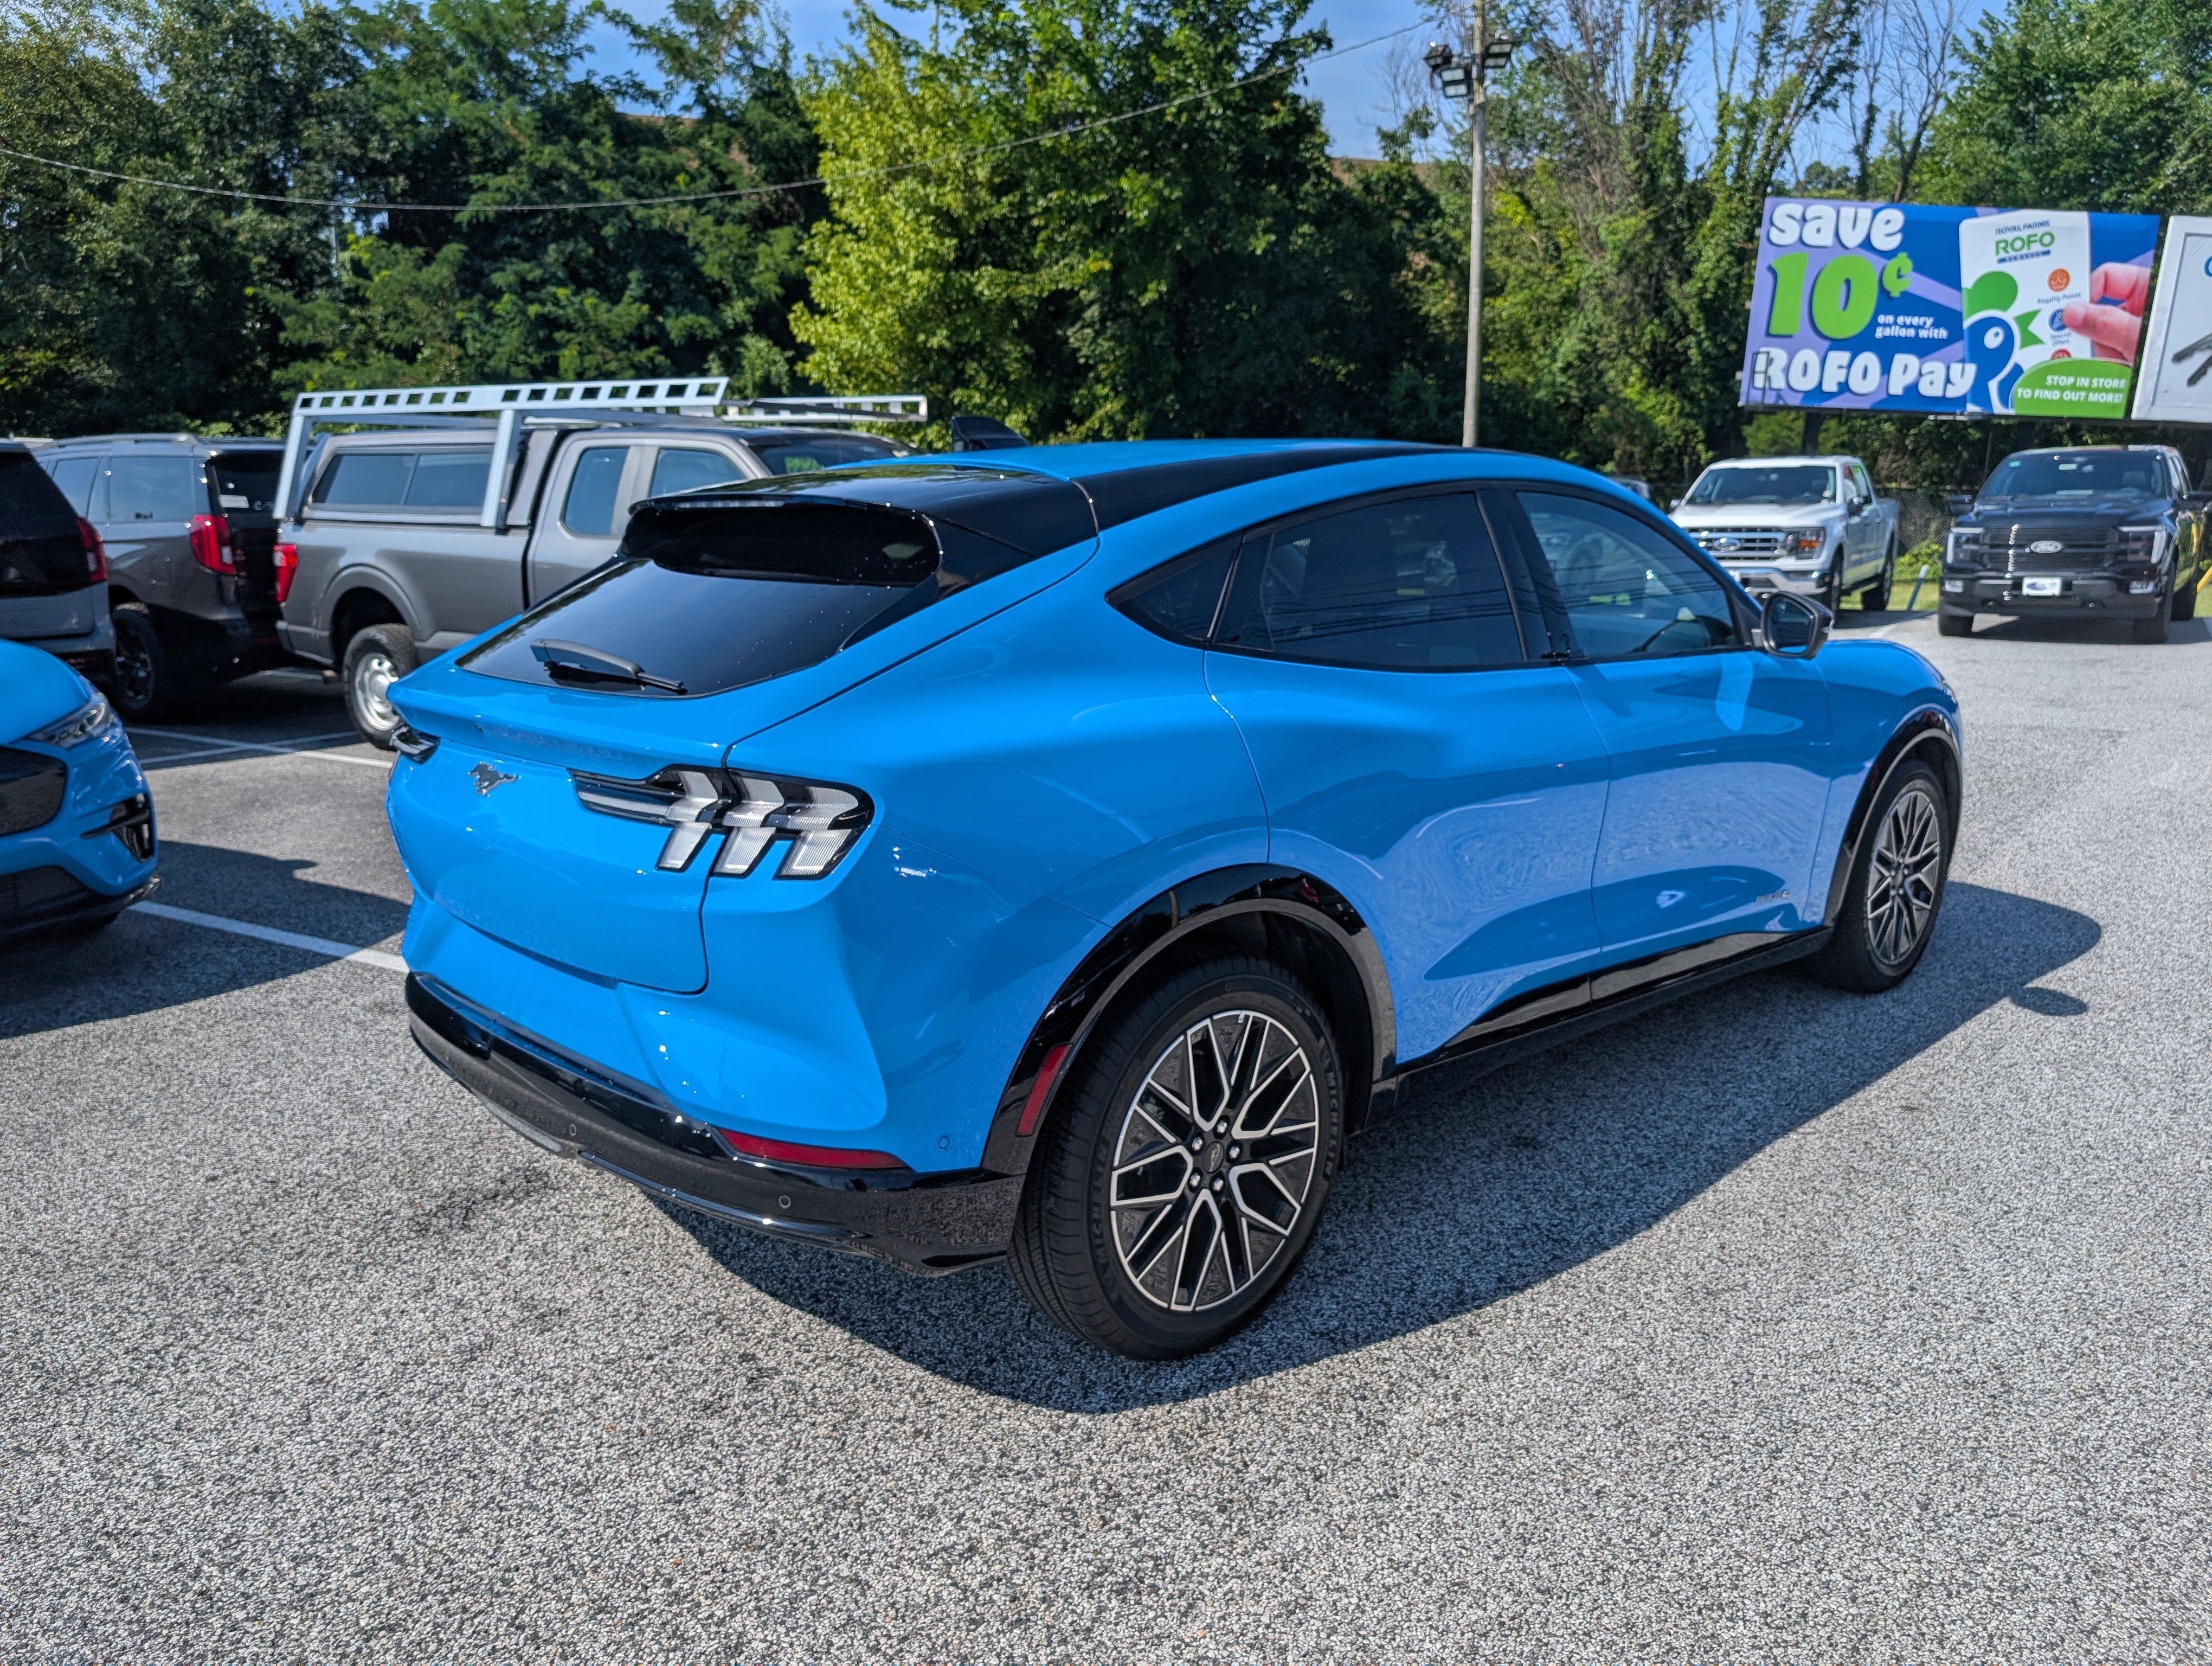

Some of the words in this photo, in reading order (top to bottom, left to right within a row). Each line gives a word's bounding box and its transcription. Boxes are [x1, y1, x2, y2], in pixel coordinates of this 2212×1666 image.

[1769, 203, 1905, 251] save
[1995, 225, 2022, 235] ROYAL
[2022, 220, 2050, 230] FARMS
[1995, 231, 2055, 256] ROFO
[1877, 314, 1895, 325] on
[1896, 315, 1934, 329] every
[1874, 325, 1916, 339] gallon
[1918, 326, 1949, 339] with
[1753, 347, 1881, 395] ROFO
[1888, 353, 1977, 399] Pay
[2046, 375, 2074, 387] STOP
[2076, 377, 2089, 388] IN
[2091, 377, 2126, 389] STORE
[2017, 388, 2032, 399] TO
[2034, 389, 2060, 401] FIND
[2062, 390, 2086, 402] OUT
[2088, 392, 2123, 404] MORE!
[1326, 1072, 1339, 1175] MICHELIN
